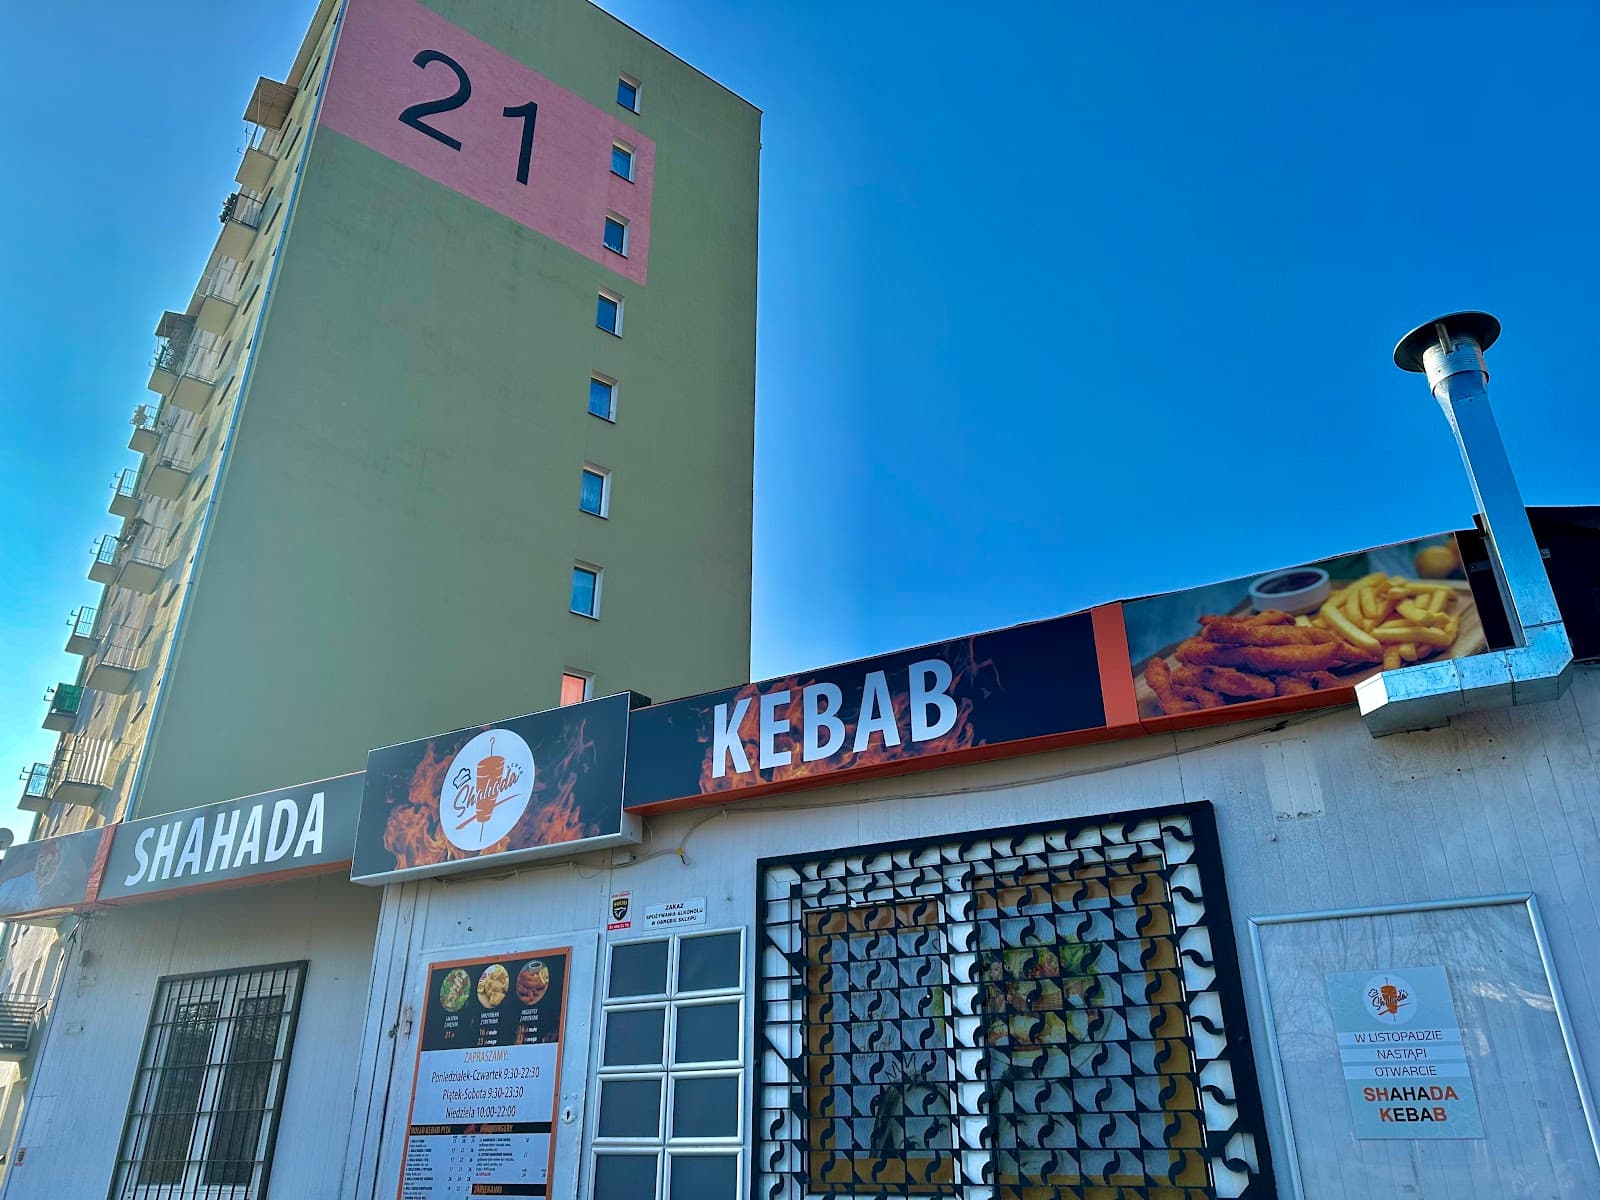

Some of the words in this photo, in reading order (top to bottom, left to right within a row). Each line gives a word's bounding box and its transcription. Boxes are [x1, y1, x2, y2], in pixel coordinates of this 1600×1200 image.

[398, 49, 538, 186] 21
[711, 658, 958, 779] KEBAB
[453, 768, 521, 818] Shahada
[124, 791, 325, 887] SHAHADA
[665, 903, 684, 911] ZAKAZ
[1354, 1033, 1366, 1043] W
[1369, 1030, 1443, 1043] LISTOPADZIE
[1377, 1048, 1427, 1061] NASTĄPI
[431, 1069, 503, 1083] Poniedziałek-Czwartek
[503, 1066, 540, 1080] 9:30-22:30
[1374, 1066, 1438, 1077] OTWARCIE
[442, 1087, 487, 1103] Piątek-Sobota
[487, 1086, 524, 1099] 9:30-23:30
[1363, 1086, 1460, 1102] SHAHADA
[446, 1106, 475, 1119] Niedziela
[477, 1105, 516, 1118] 10:00-22:00
[1379, 1107, 1448, 1123] KEBAB
